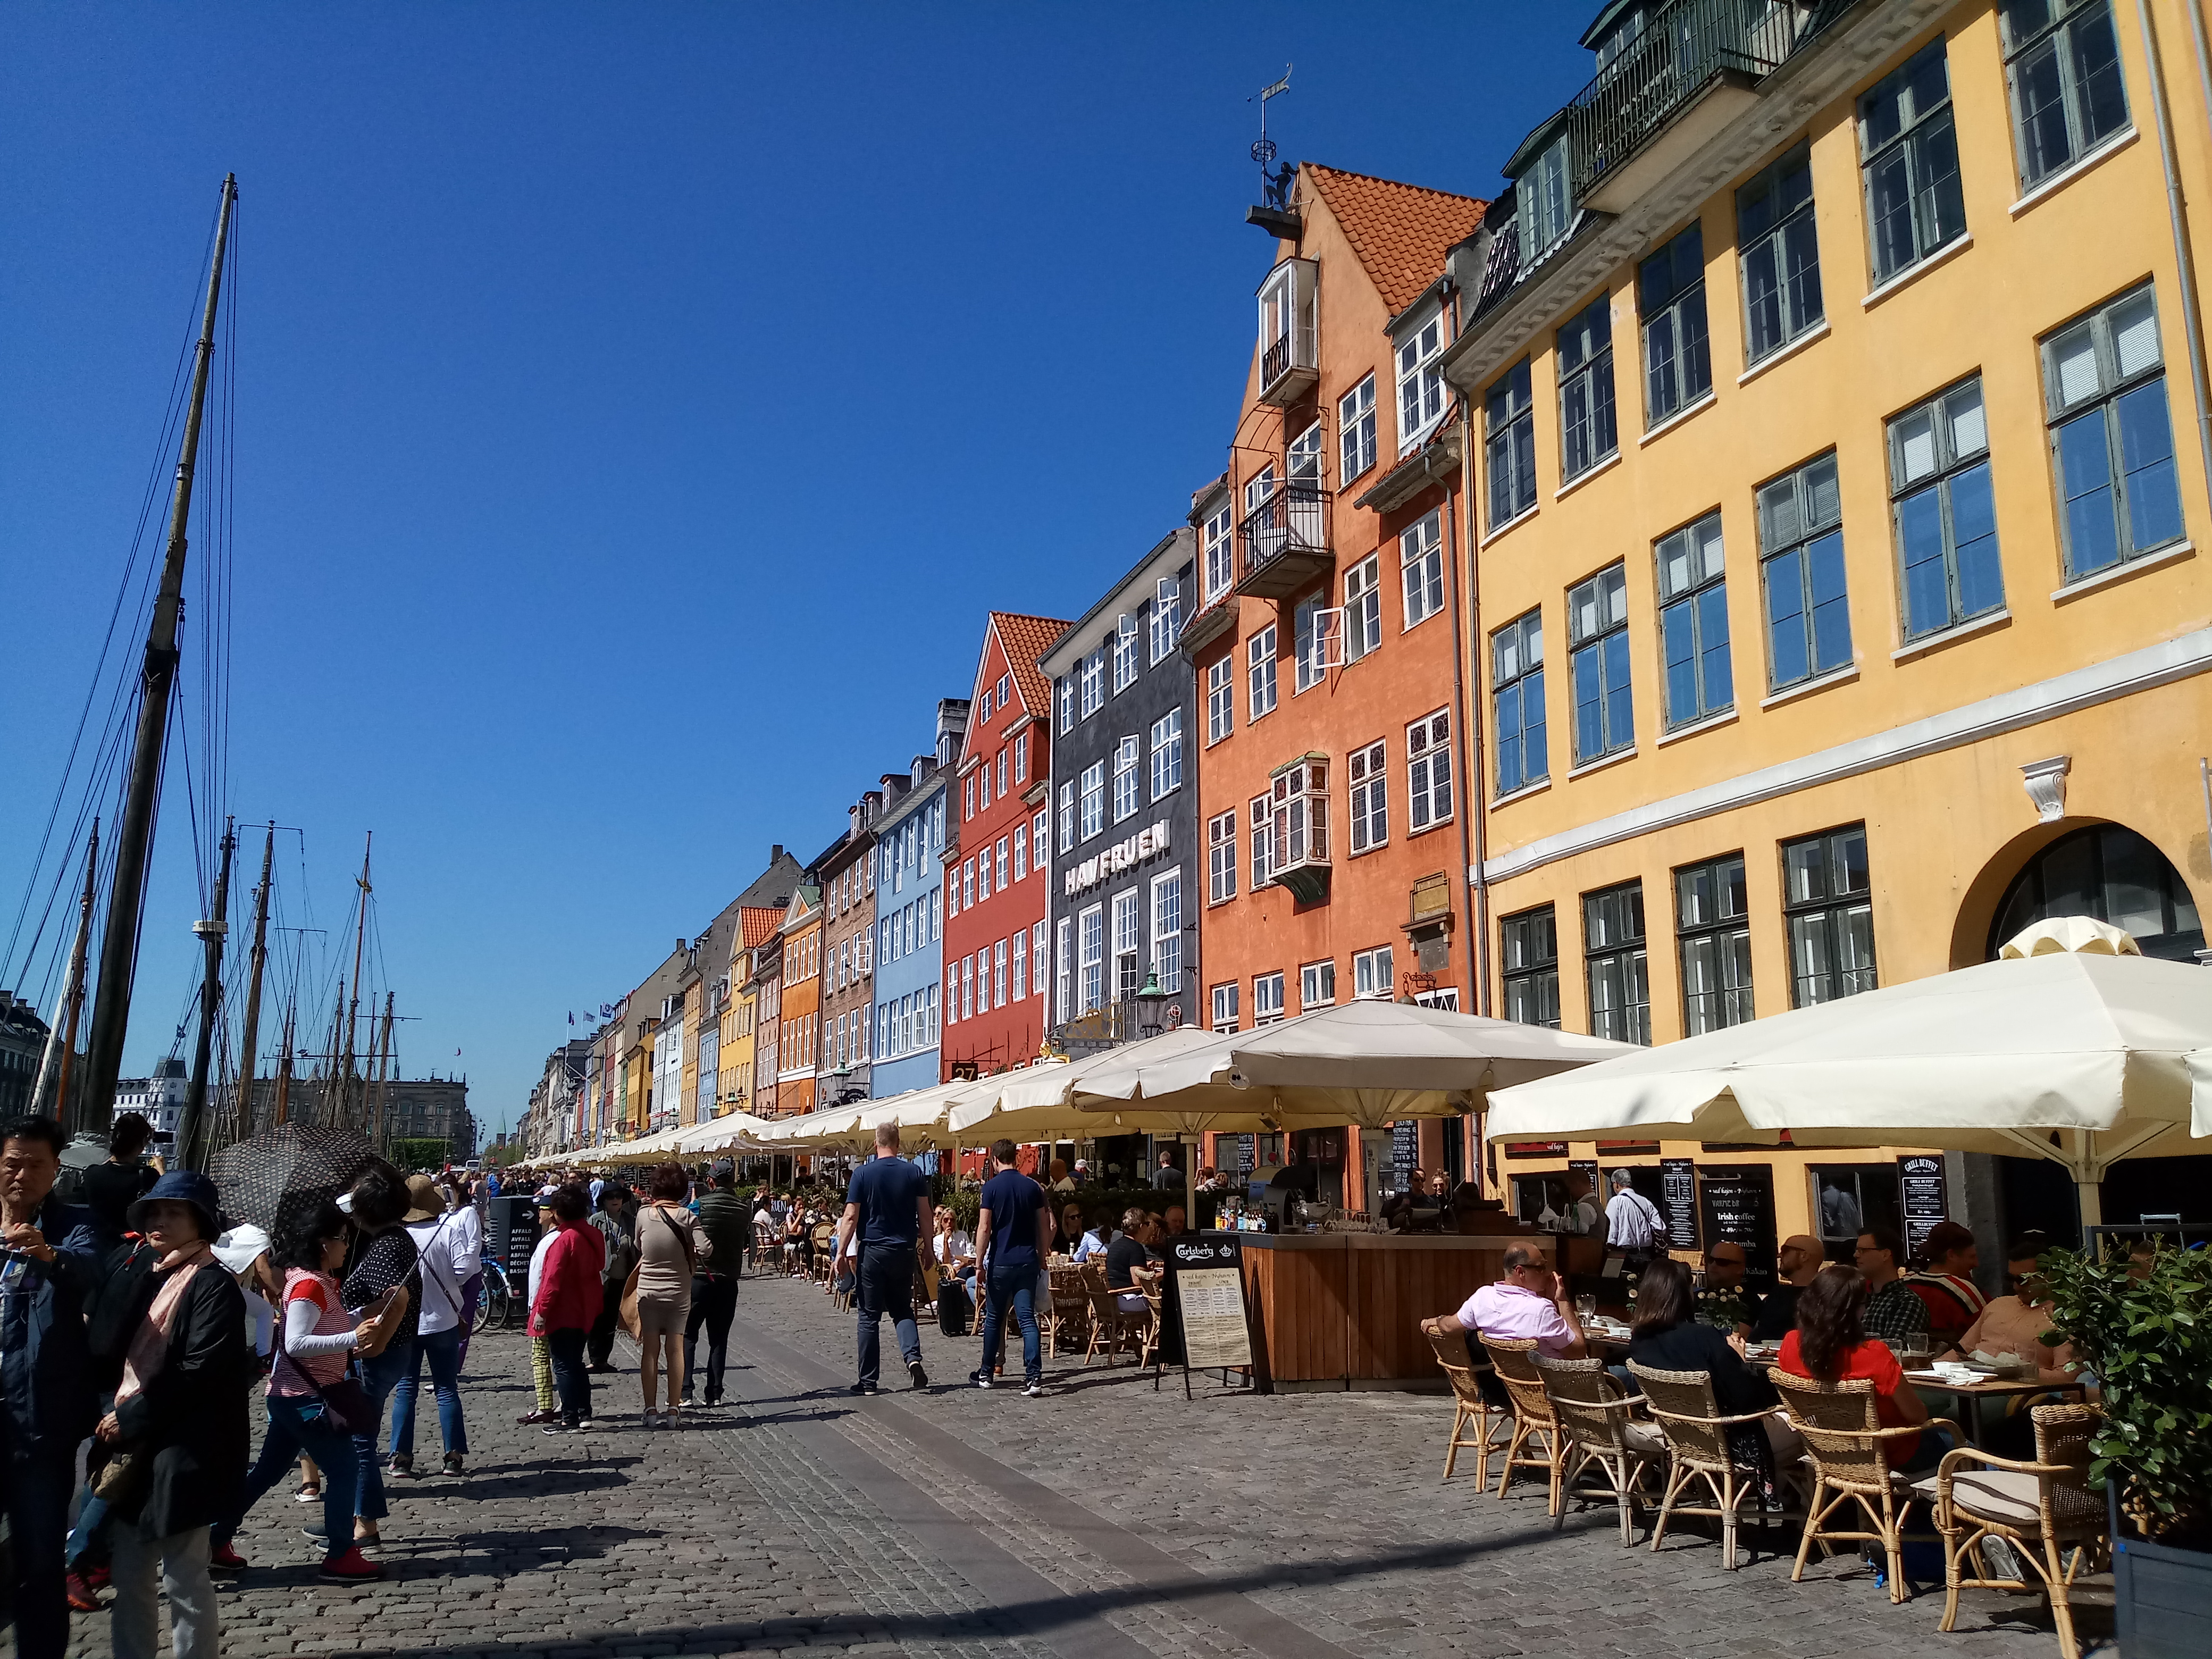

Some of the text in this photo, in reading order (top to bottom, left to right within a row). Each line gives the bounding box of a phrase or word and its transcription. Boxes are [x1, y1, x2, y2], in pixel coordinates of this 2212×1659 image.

[1065, 819, 1170, 896] HAVFRUEN
[1905, 1159, 1938, 1172] GRILL BUFFET
[1176, 1244, 1213, 1261] Carlsberg
